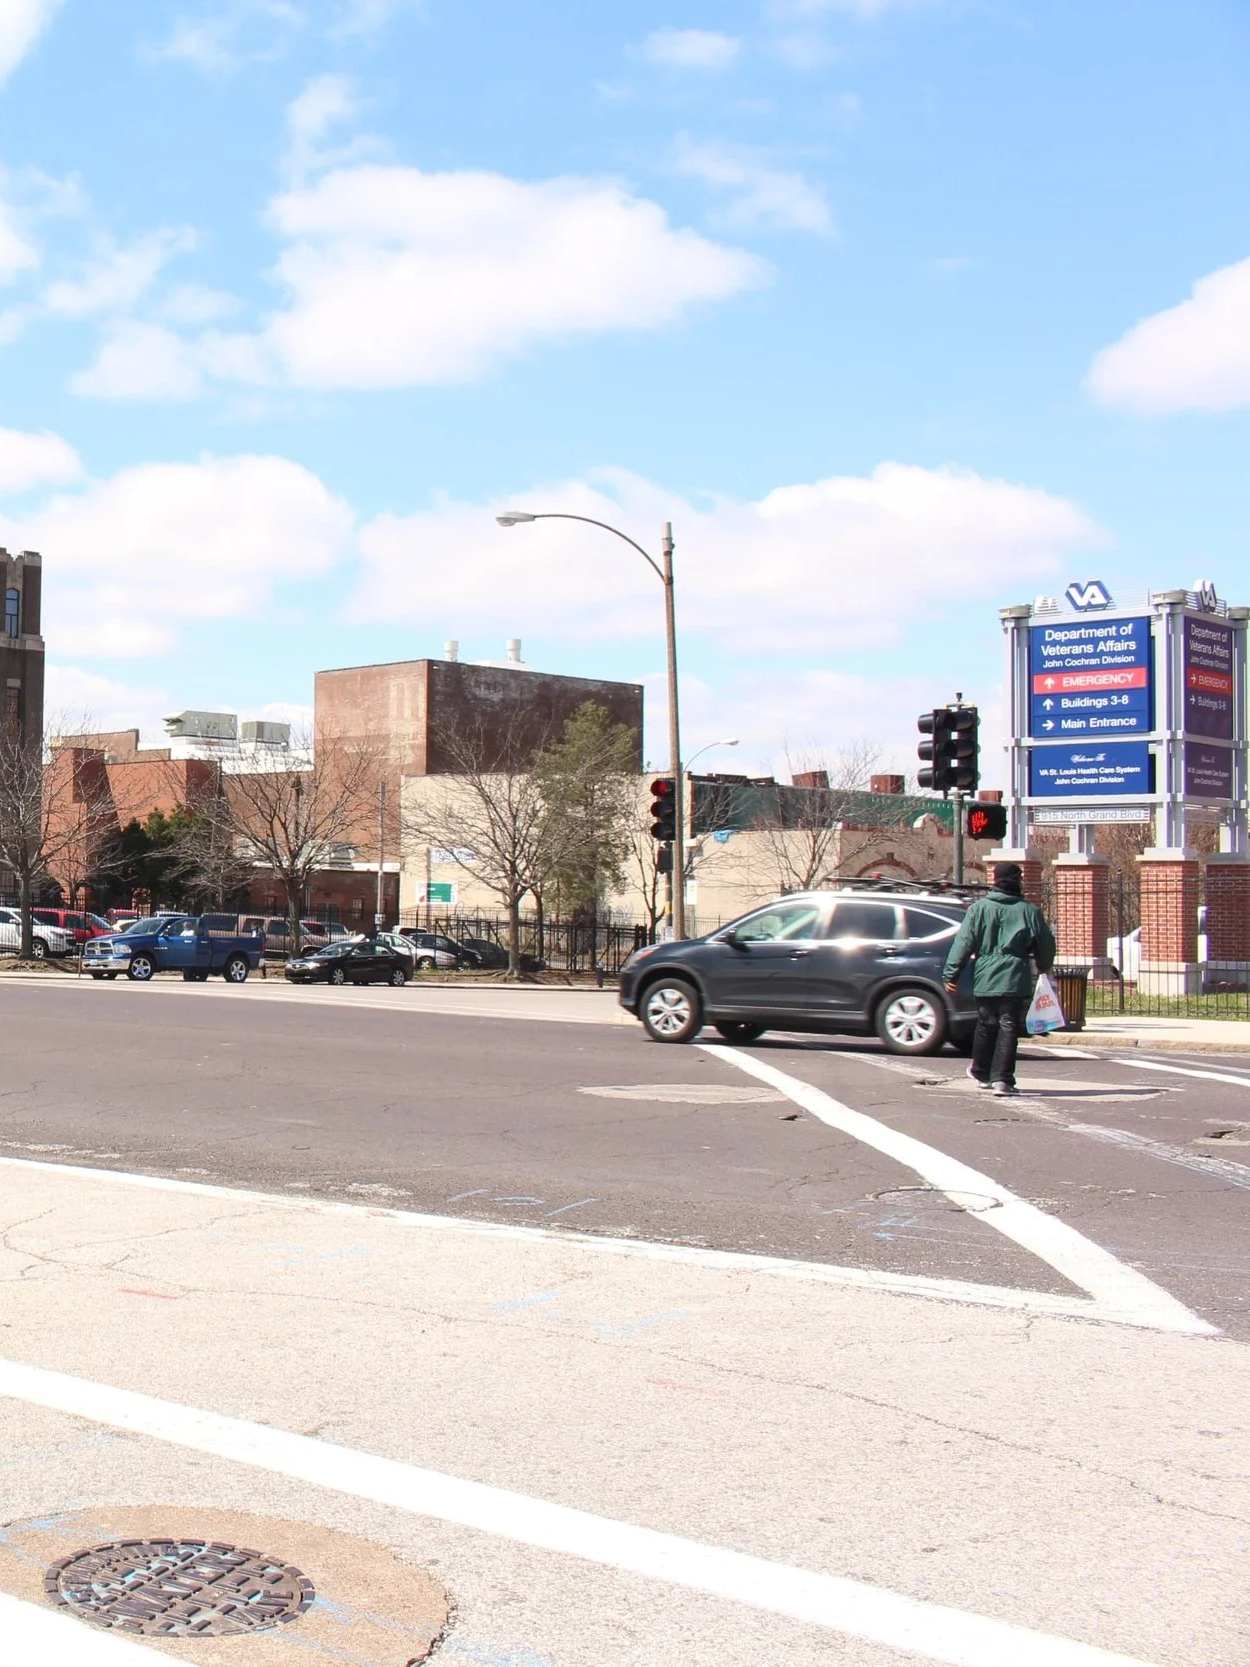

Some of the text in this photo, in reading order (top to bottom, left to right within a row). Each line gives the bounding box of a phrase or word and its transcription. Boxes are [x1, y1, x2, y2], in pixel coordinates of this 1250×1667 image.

[1067, 583, 1109, 606] VA
[1045, 623, 1133, 642] Department of
[1190, 624, 1221, 641] Department
[1041, 640, 1136, 656] Veterans Affairs
[1190, 639, 1230, 658] Veterans Affairs
[1043, 655, 1135, 668] John Cochran Division
[1062, 673, 1135, 687] EMERGENCY
[1198, 675, 1229, 689] EMERGENCY
[1061, 694, 1129, 709] Buildings 3-8
[1197, 696, 1218, 710] Buildings
[1061, 716, 1137, 729] Main Entrance
[1077, 767, 1098, 775] Health
[1116, 766, 1141, 774] System
[1061, 811, 1086, 819] North
[1089, 810, 1118, 818] Grand
[1121, 809, 1141, 818] Blvd
[106, 1552, 247, 1621] WATER
